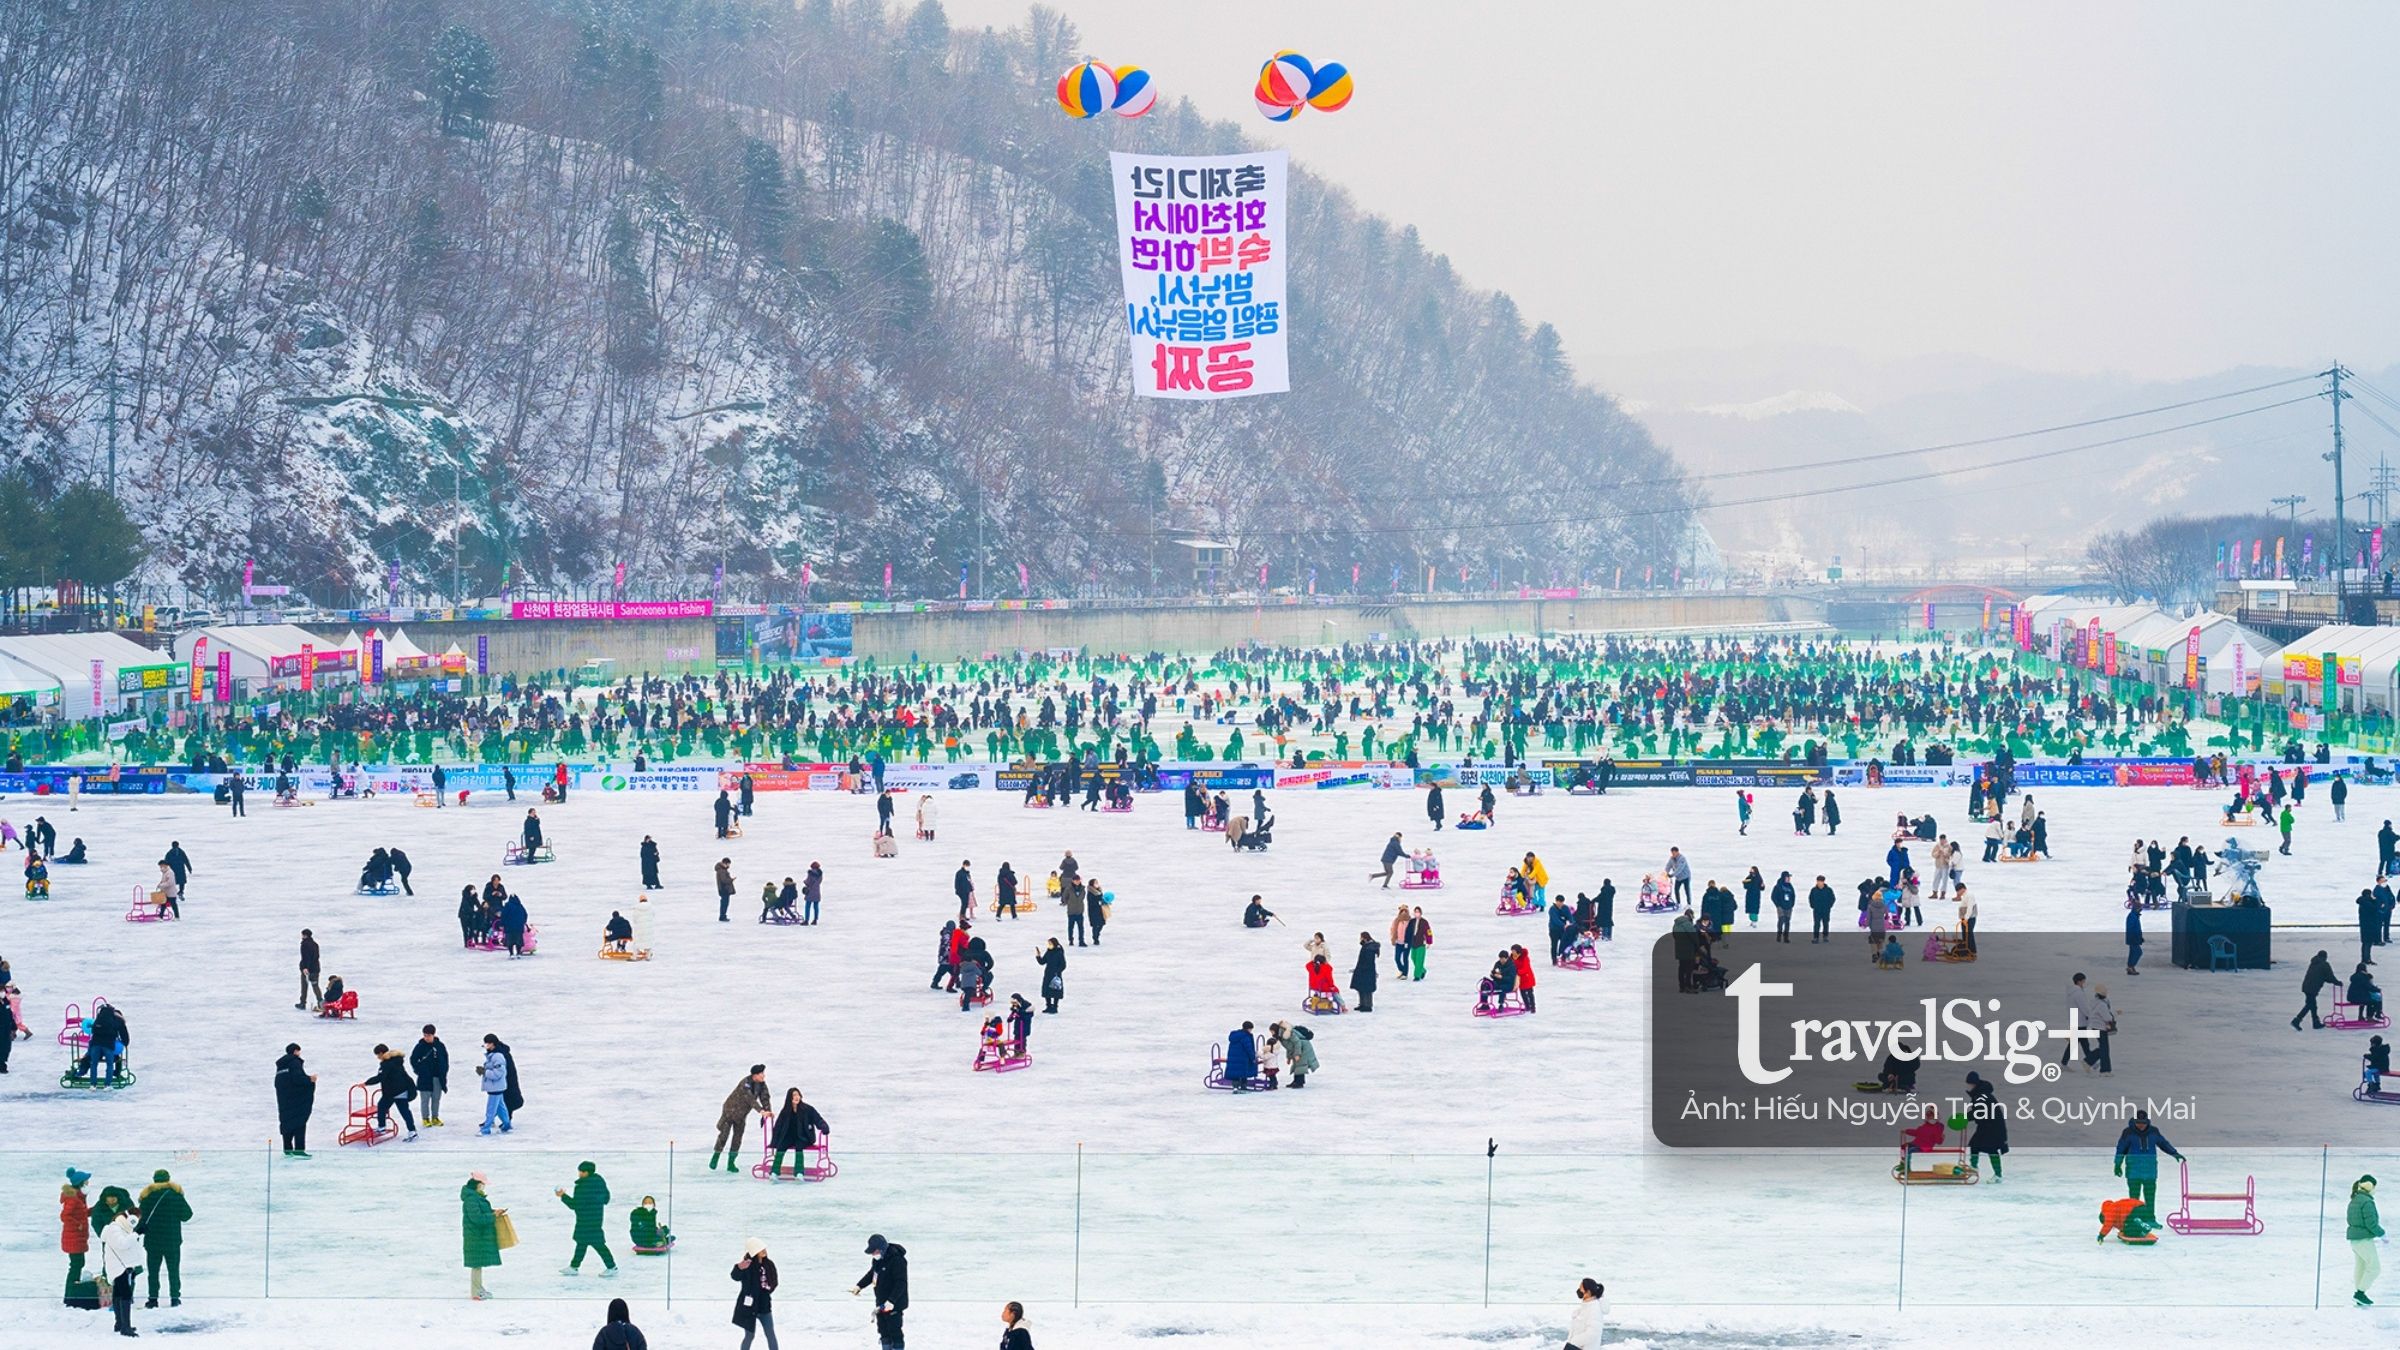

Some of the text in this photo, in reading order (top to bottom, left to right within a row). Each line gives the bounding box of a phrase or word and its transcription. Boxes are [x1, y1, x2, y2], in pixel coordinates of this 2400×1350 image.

[522, 603, 550, 617] 산천어
[620, 603, 667, 616] Sancheoneo
[667, 603, 679, 615] Ice
[679, 602, 706, 615] Fishing
[257, 776, 301, 790] 케이카
